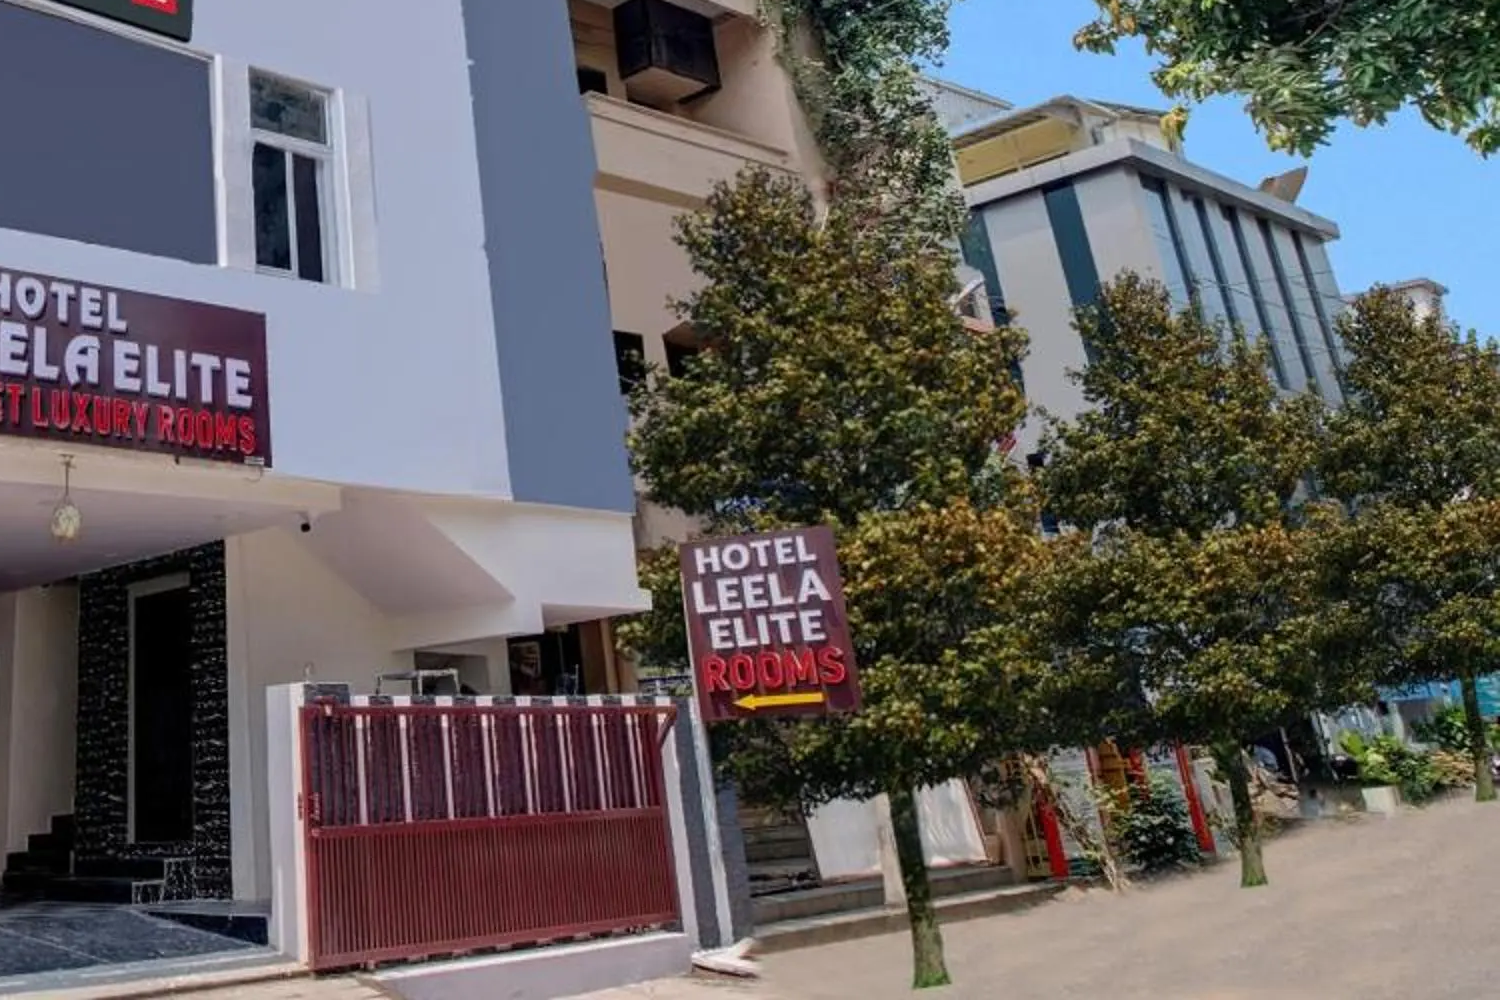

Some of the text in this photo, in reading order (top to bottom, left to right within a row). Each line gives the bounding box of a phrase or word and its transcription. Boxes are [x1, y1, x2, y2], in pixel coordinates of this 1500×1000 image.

[112, 341, 254, 409] ELITE
[32, 386, 148, 440] LUXURY
[157, 404, 258, 455] ROOMS
[694, 535, 817, 575] HOTEL
[692, 568, 832, 614] LEELA
[708, 609, 827, 650] ELITE
[702, 647, 846, 693] ROOMS
